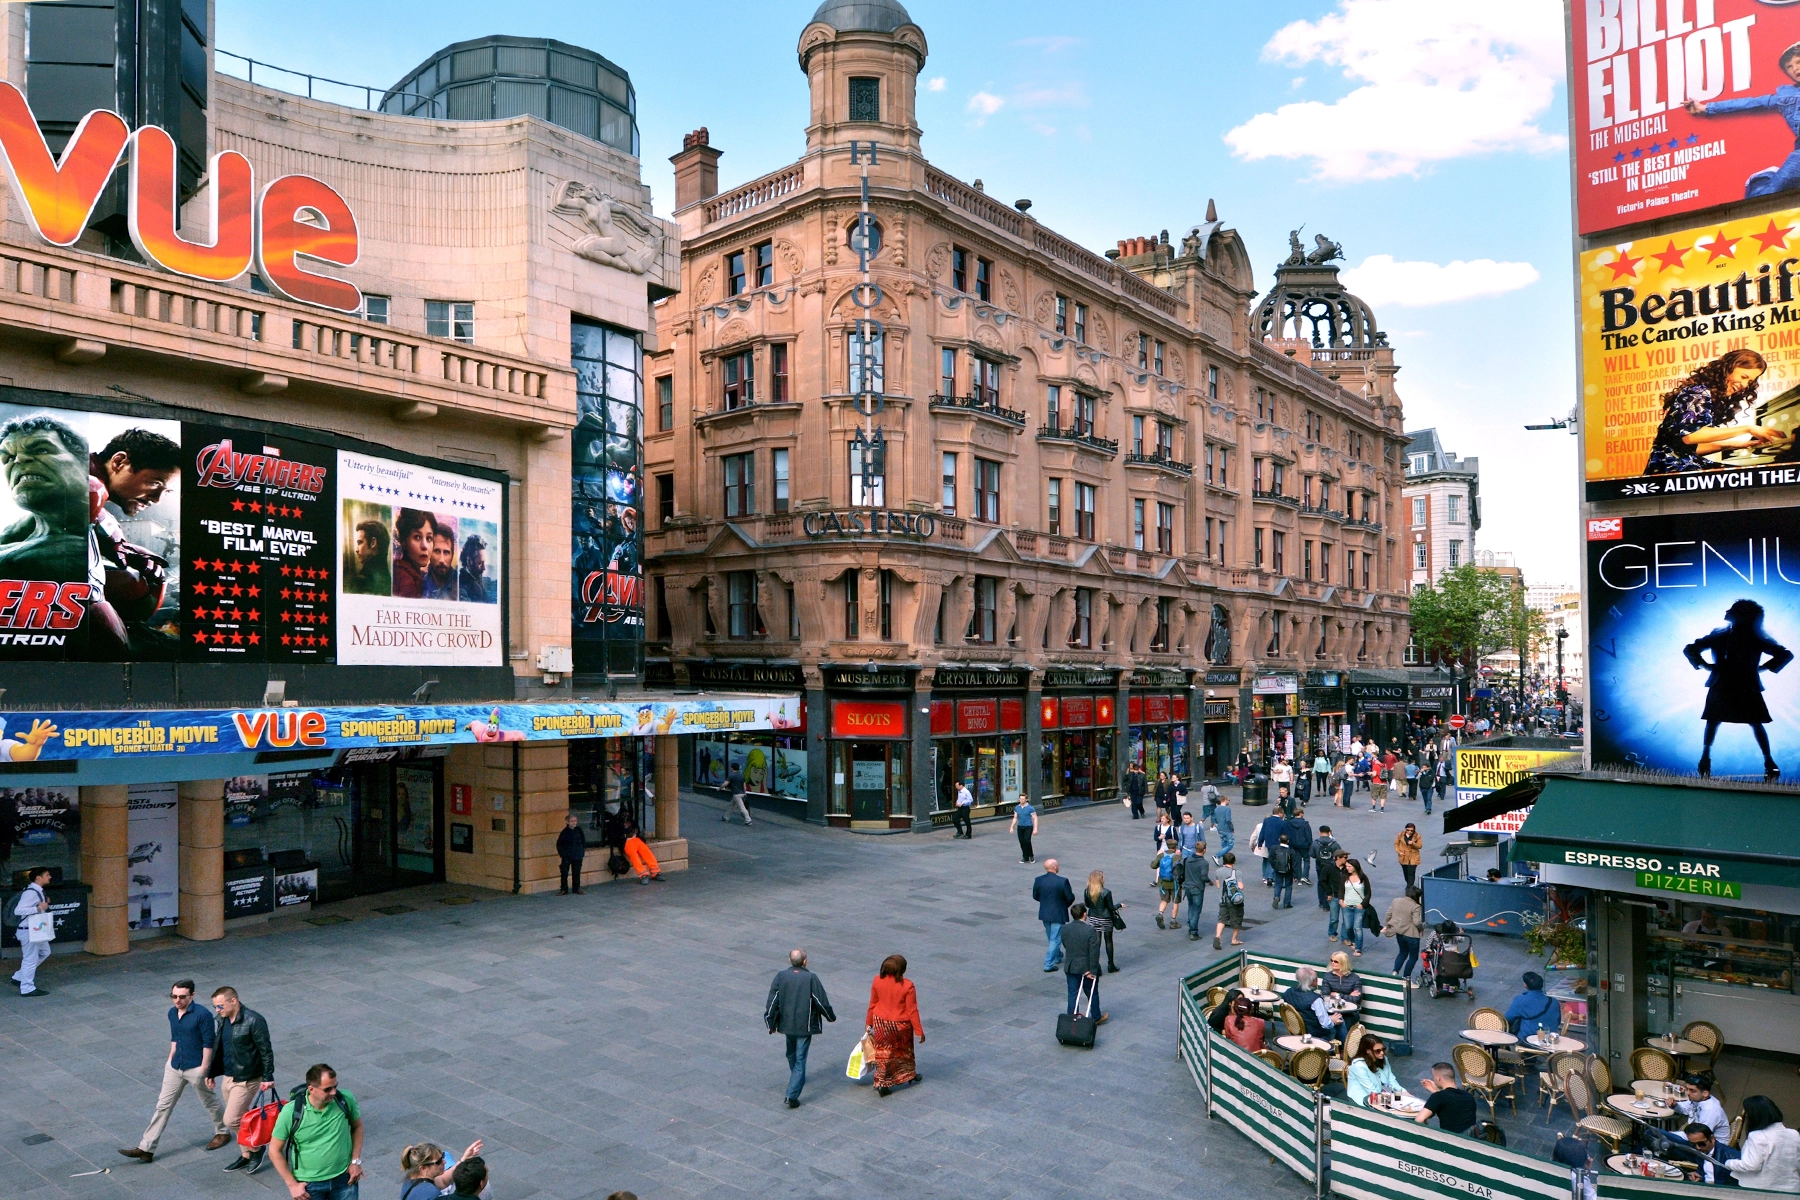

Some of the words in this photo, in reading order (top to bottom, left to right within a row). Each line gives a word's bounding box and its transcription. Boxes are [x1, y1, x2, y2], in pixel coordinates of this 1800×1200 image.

[1587, 14, 1755, 131] ELLIOT
[1590, 131, 1609, 151] THE
[1614, 114, 1668, 145] MUSICAL
[1621, 160, 1640, 179] THE
[1644, 152, 1671, 174] BEST
[1674, 139, 1726, 166] MUSICAL
[1626, 176, 1638, 192] IN
[1617, 200, 1644, 215] Victoria
[1646, 195, 1669, 208] Palace
[1671, 189, 1699, 203] Theatre
[1600, 257, 1800, 333] Beautif
[1601, 332, 1639, 350] The
[1642, 320, 1708, 344] Carole
[1712, 310, 1765, 334] King
[1604, 353, 1640, 373] WILL
[1646, 346, 1676, 367] YOU
[1682, 340, 1720, 362] LOVE
[1604, 374, 1623, 386] TAKE
[1625, 370, 1646, 382] GOOD
[1649, 367, 1669, 380] CARE
[1671, 365, 1682, 376] OF
[1684, 363, 1697, 374] MY
[1637, 381, 1653, 394] GOT
[1655, 380, 1661, 391] A
[1605, 398, 1626, 413] ONE
[1631, 393, 1655, 409] FINE
[1605, 428, 1615, 438] UP
[1618, 428, 1628, 437] ON
[1631, 426, 1644, 436] THE
[1606, 436, 1655, 455] BEAUTIF
[196, 439, 327, 494] AVENGERS
[1664, 472, 1752, 492] ALDWYCH
[234, 484, 261, 493] AGE
[281, 490, 317, 502] ULTRON
[803, 509, 935, 538] CASINO
[1589, 519, 1620, 532] RSC
[262, 525, 318, 544] MARVEL
[223, 536, 264, 552] FILM
[376, 609, 401, 625] FAR
[405, 611, 442, 627] FROM
[446, 613, 472, 628] THE
[351, 625, 433, 648] MADDING
[437, 630, 493, 649] CROWD
[702, 667, 749, 680] CRYSTAL
[753, 668, 796, 682] ROOMS
[834, 673, 906, 684] AMUSEMENTS
[939, 672, 982, 685] CRYSTAL
[986, 672, 1019, 685] ROOMS
[1047, 672, 1082, 685] CRYSTAL
[1084, 671, 1111, 684] ROOMS
[1352, 686, 1403, 697] CASINO
[682, 711, 730, 725] SPONGEBOB
[731, 710, 755, 722] MOVIE
[848, 713, 891, 726] SLOTS
[963, 706, 990, 716] CRYSTAL
[138, 720, 151, 728] THE
[341, 719, 417, 737] SPONGEBOB
[419, 718, 456, 734] MOVIE
[533, 715, 591, 731] SPONGEBOB
[593, 714, 622, 728] MOVIE
[967, 718, 988, 729] BINGO
[64, 727, 166, 747] SPONGEBOB
[169, 726, 219, 744] MOVIE
[113, 744, 142, 753] SPONGE
[150, 743, 174, 752] WATER
[1461, 752, 1501, 770] SUNNY
[14, 820, 32, 832] BOX
[35, 818, 66, 830] OFFICE
[1478, 822, 1519, 831] THEATRE
[1565, 851, 1662, 872] ESPRESSO
[1679, 862, 1720, 878] BAR
[1644, 873, 1734, 897] PIZZERIA
[1398, 1160, 1457, 1187] ESPRESSO
[1468, 1182, 1493, 1199] BAR
